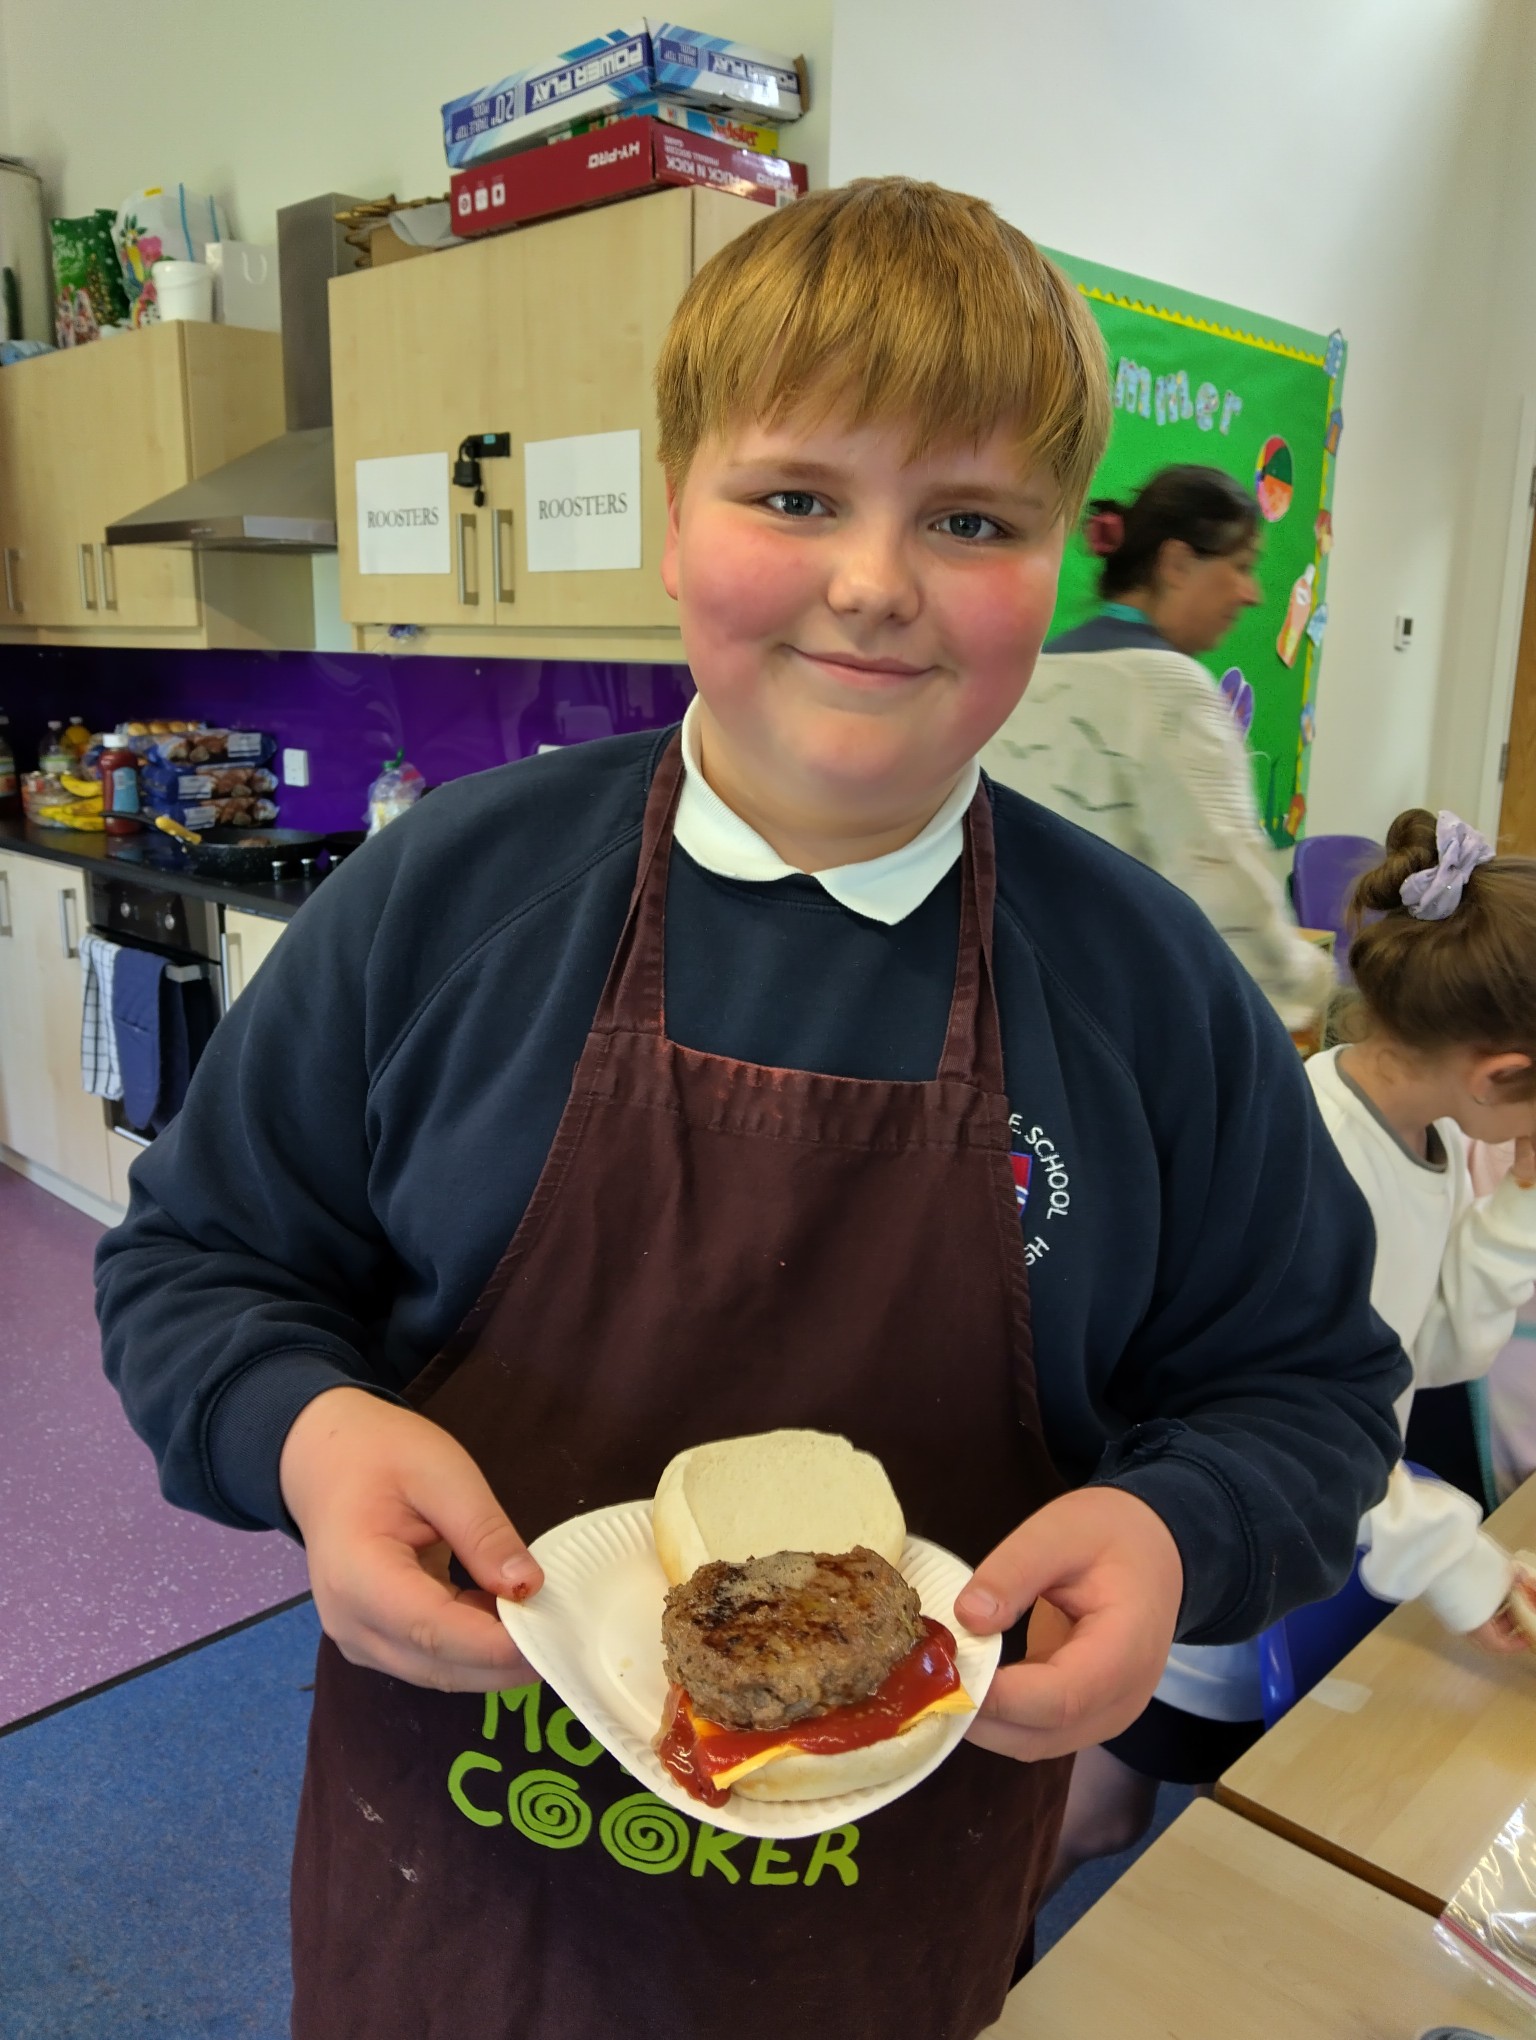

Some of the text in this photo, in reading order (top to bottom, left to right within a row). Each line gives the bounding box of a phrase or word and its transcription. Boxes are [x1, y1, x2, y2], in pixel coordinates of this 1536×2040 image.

[531, 41, 644, 105] POWER PLAY
[588, 141, 641, 169] HY-PRO
[665, 154, 696, 176] KICK
[1113, 355, 1244, 437] mmer
[366, 506, 440, 529] ROOSTERS
[539, 492, 629, 520] ROOSTERS
[1024, 1126, 1071, 1220] SCHOOL
[481, 1681, 630, 1773] MO
[447, 1749, 861, 1888] COOKER
